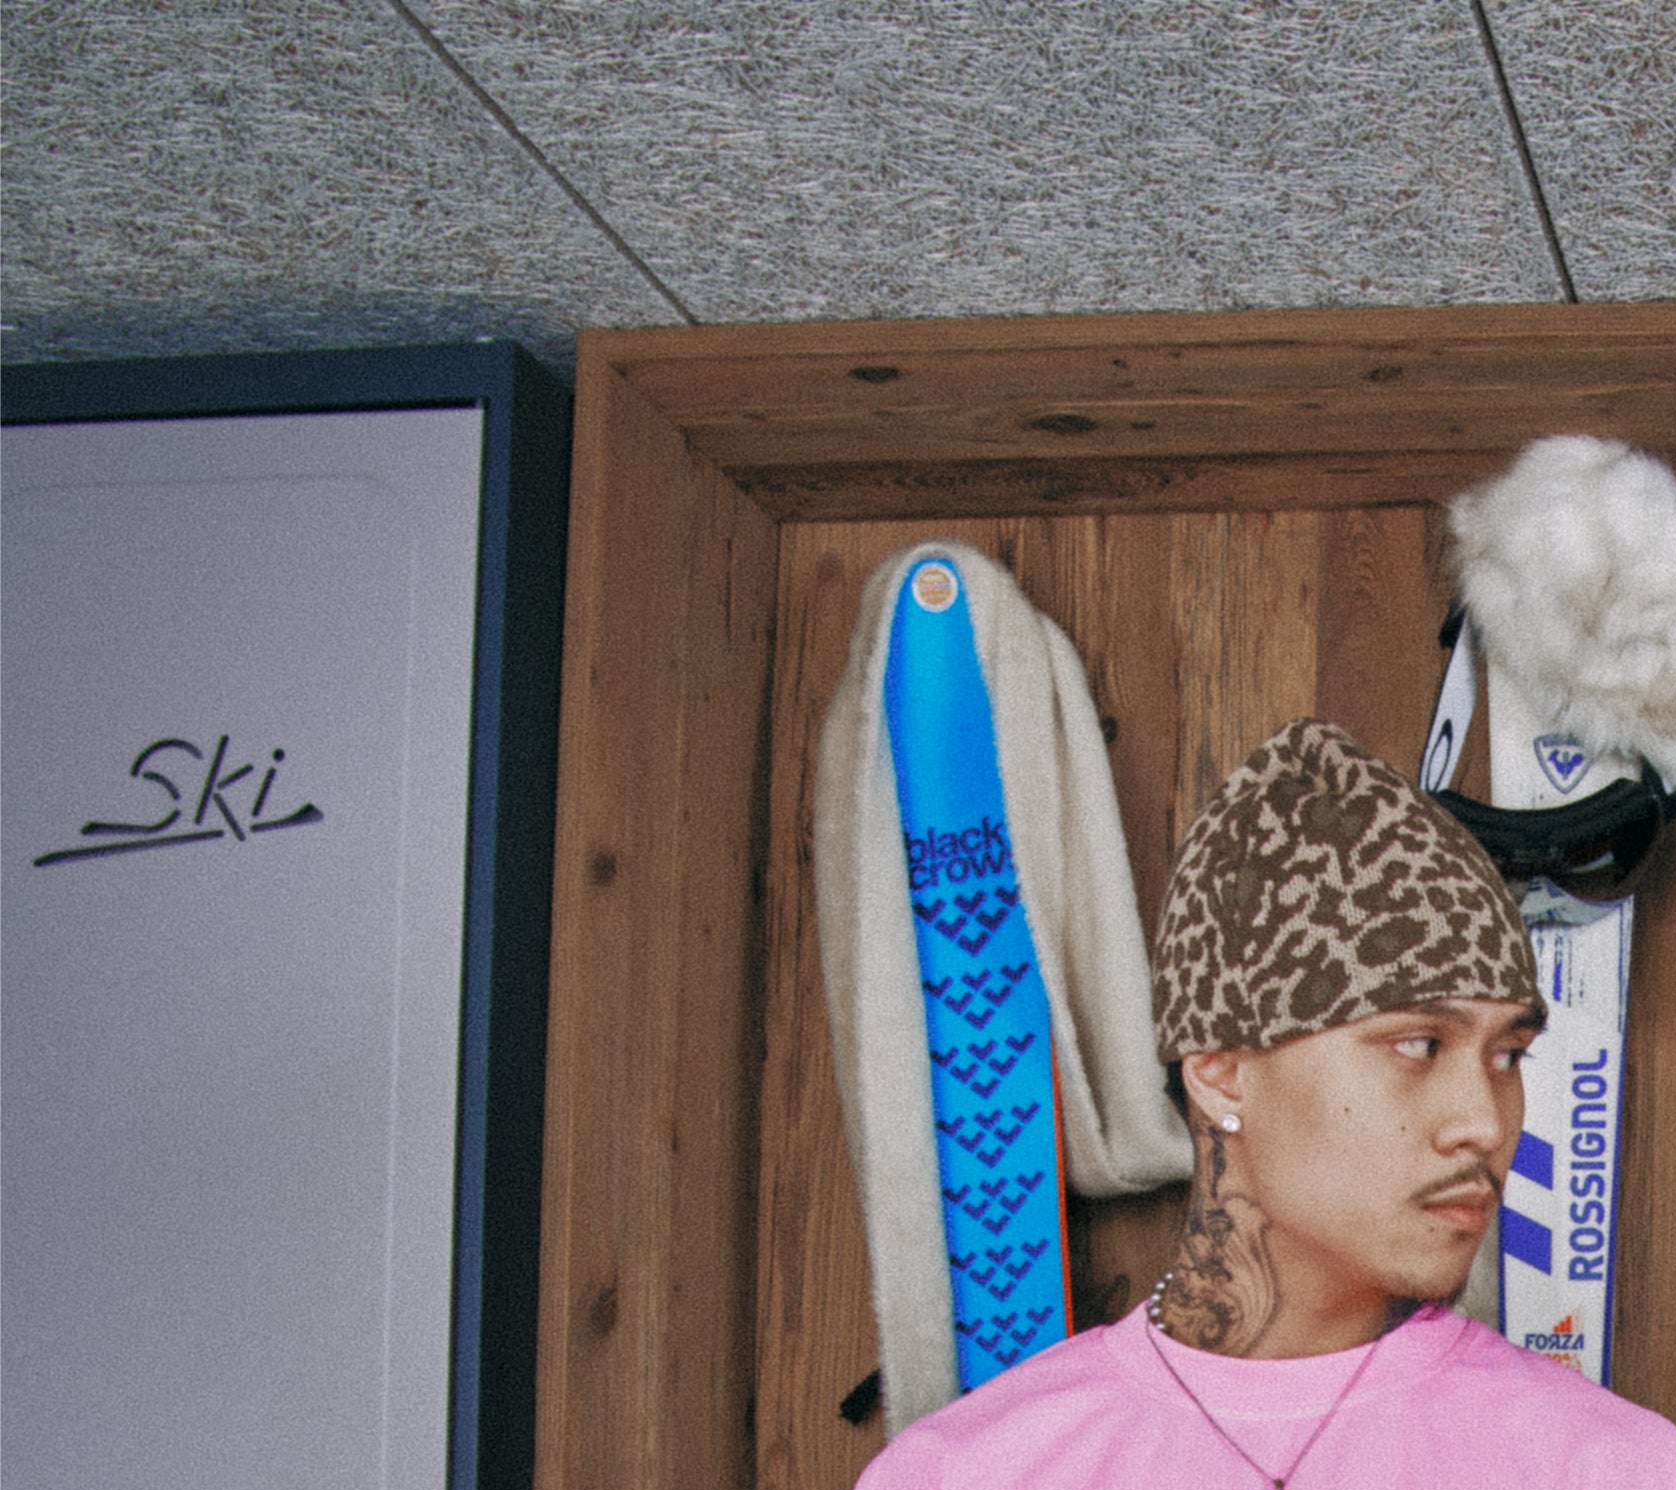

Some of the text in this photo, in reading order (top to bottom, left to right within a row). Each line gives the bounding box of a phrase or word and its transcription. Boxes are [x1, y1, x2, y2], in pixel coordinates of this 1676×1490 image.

[80, 733, 324, 842] Ski
[904, 816, 1005, 864] black
[1568, 1048, 1608, 1281] ROSSIGNOL
[1525, 1332, 1584, 1350] FORZA
